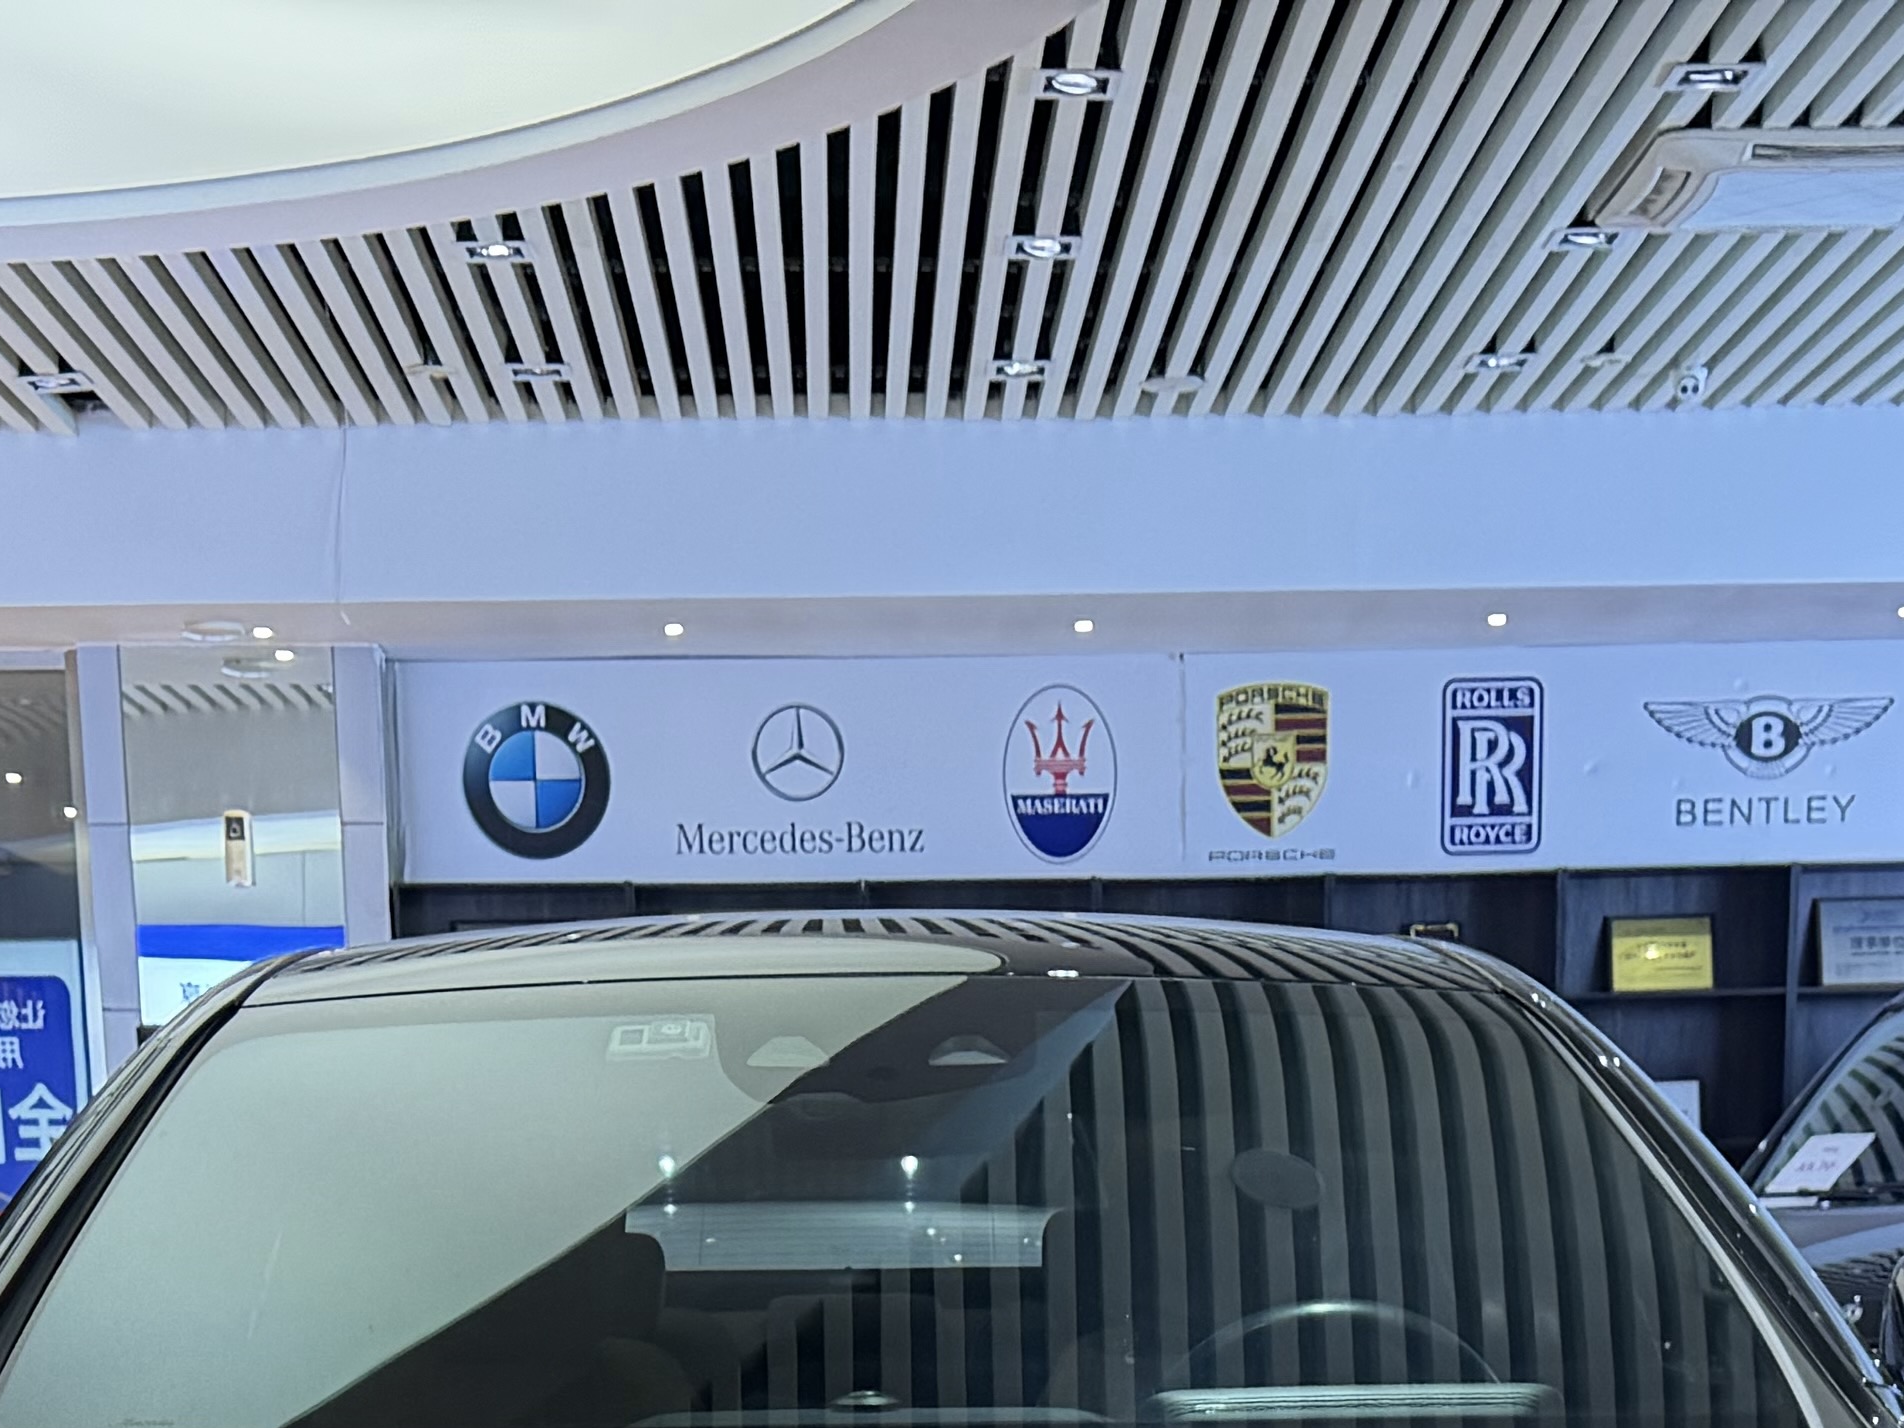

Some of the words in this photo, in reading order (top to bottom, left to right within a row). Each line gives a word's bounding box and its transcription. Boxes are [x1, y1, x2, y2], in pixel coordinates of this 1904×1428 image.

[1219, 684, 1328, 706] PORSCHE
[1456, 688, 1532, 710] ROLLS
[475, 703, 596, 754] BMW
[1016, 798, 1103, 816] MASERATI
[1676, 795, 1856, 827] BENTLEY
[675, 821, 927, 856] Mercedes-Benz
[1454, 823, 1529, 846] ROYCE
[1208, 848, 1336, 862] PORSCHE
